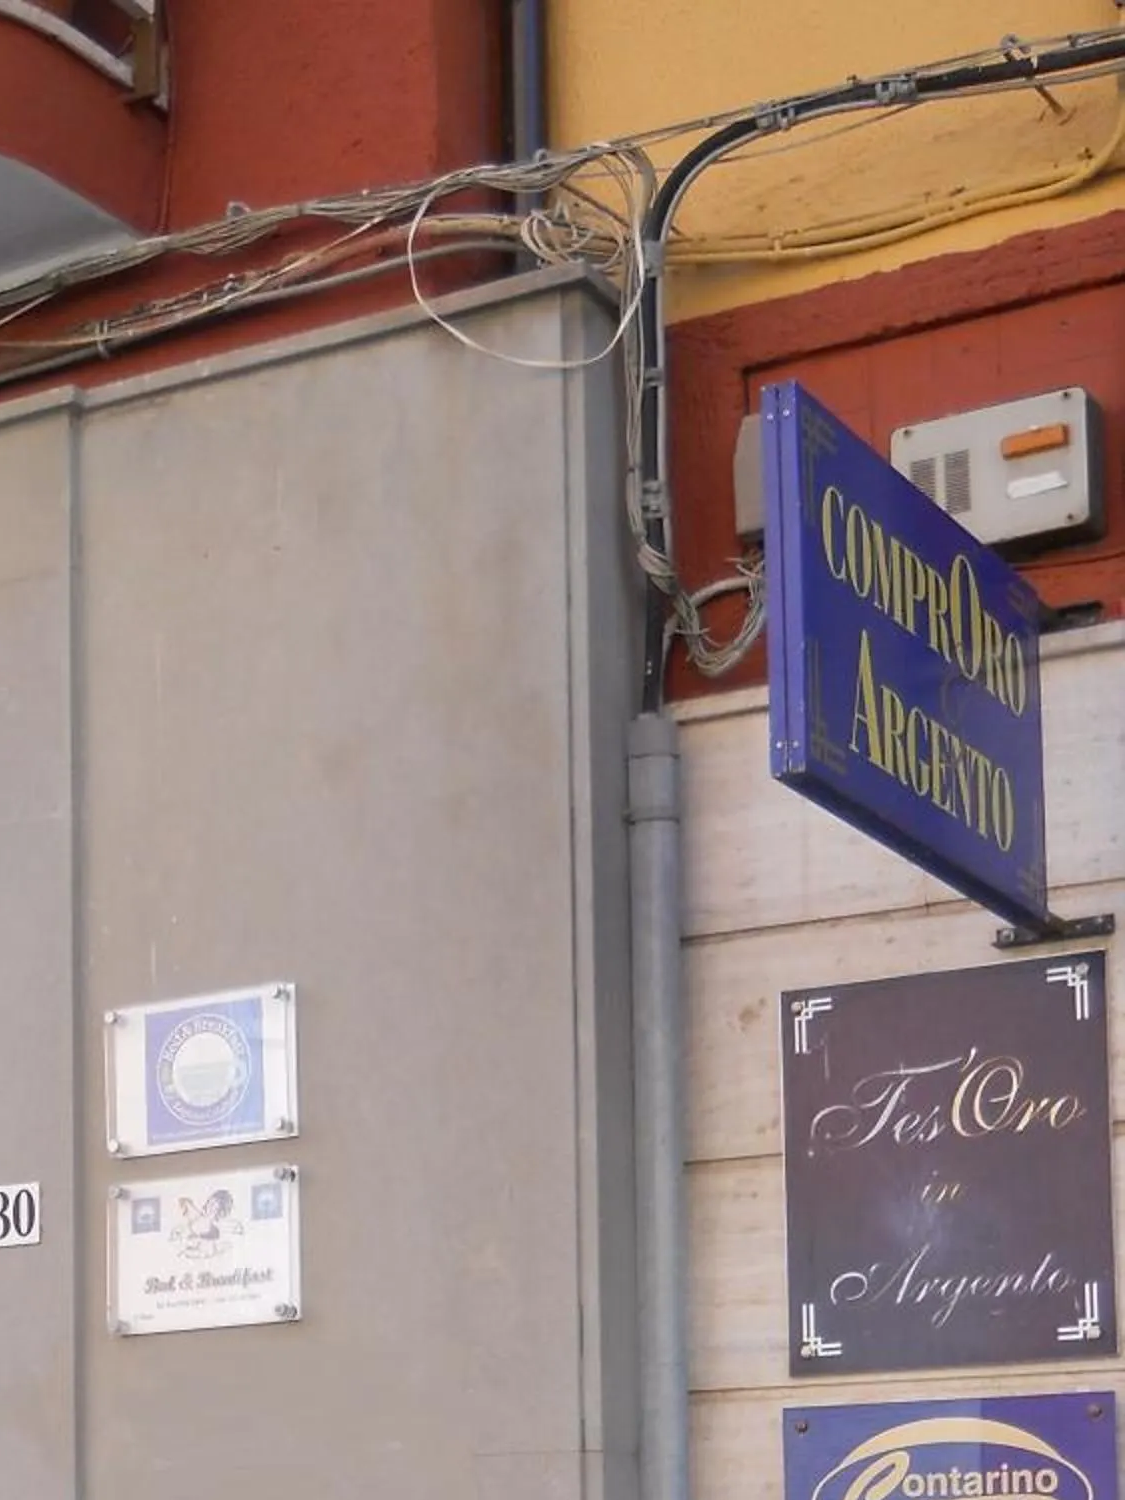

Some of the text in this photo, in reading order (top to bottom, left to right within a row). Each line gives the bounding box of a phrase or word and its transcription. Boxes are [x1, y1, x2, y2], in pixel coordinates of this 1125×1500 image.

[848, 629, 1014, 852] ARGENTO
[920, 1170, 964, 1203] in
[178, 1271, 194, 1291] &
[830, 1243, 1075, 1328] Argento
